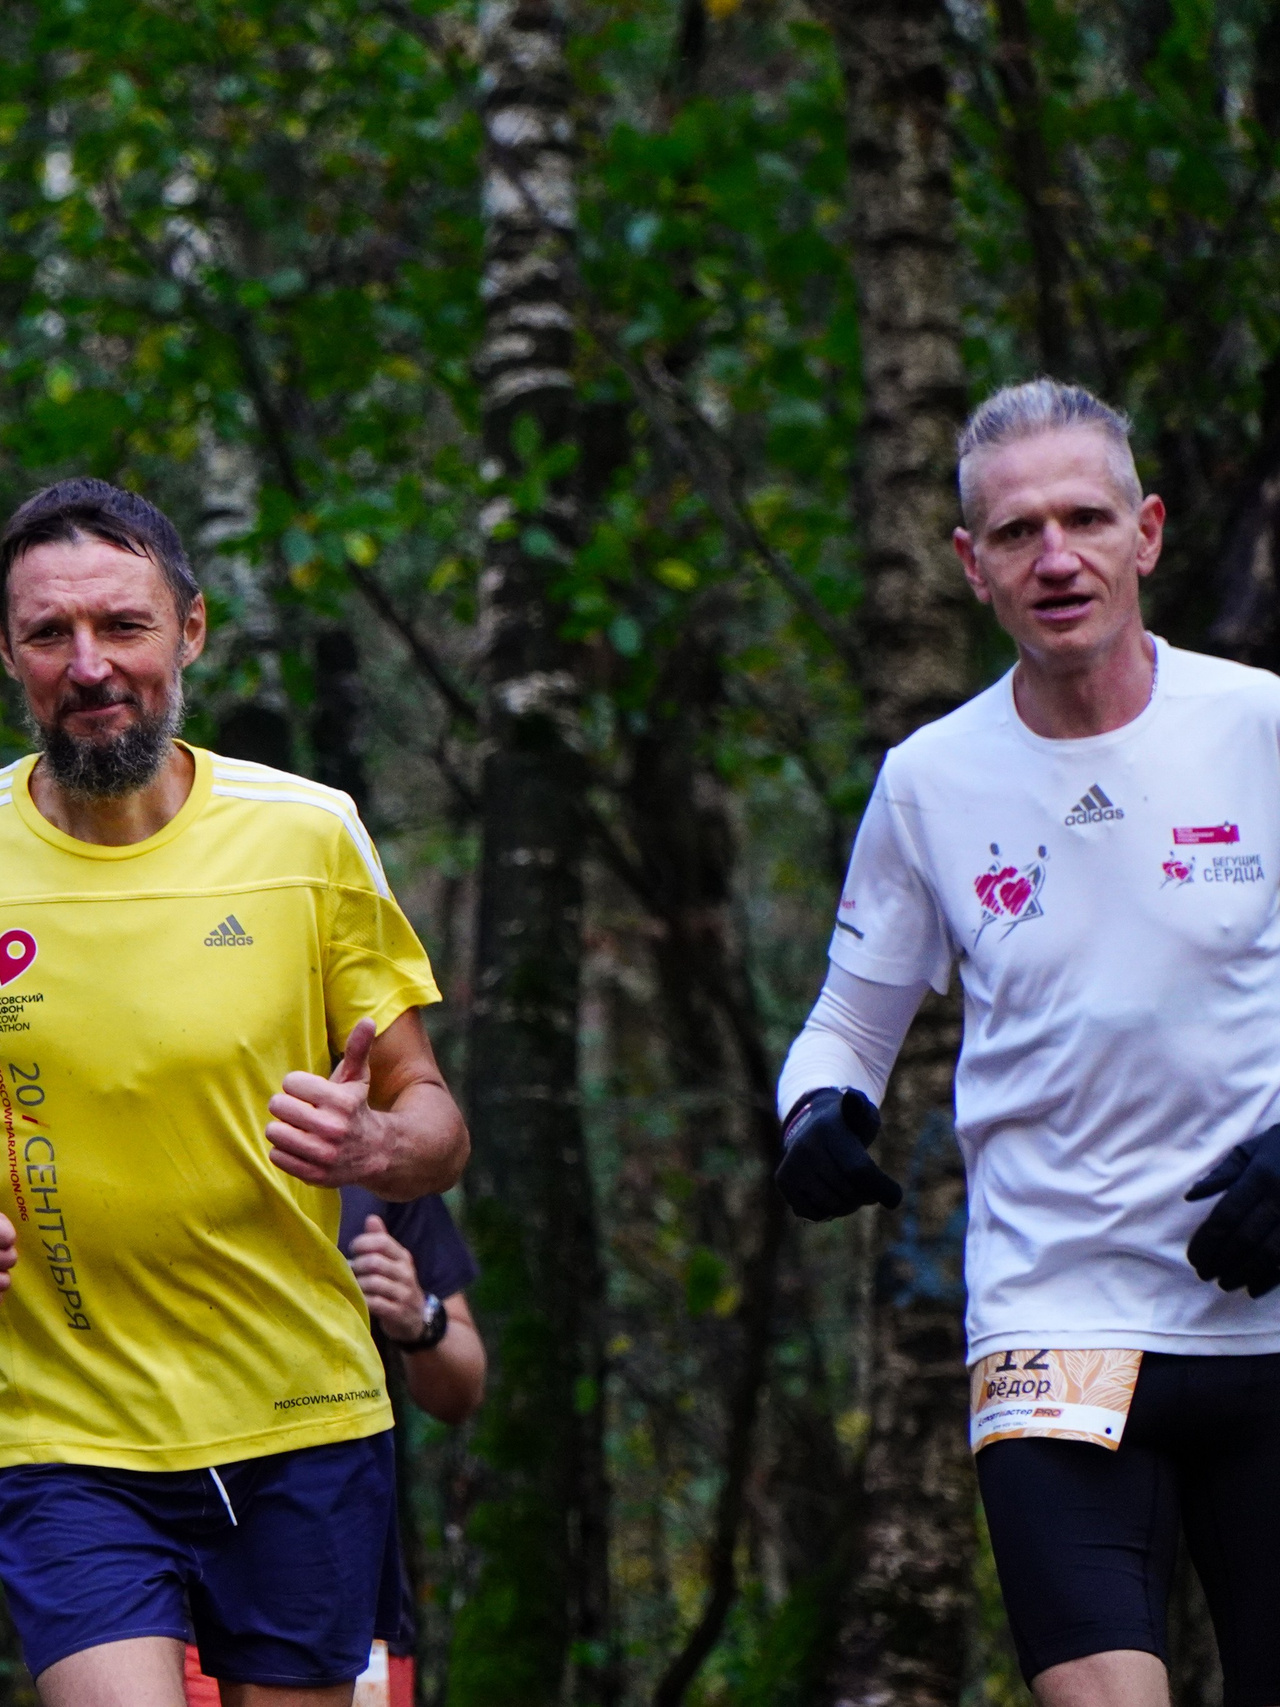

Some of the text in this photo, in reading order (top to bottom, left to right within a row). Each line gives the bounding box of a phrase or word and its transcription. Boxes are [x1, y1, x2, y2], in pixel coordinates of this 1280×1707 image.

[1065, 807, 1124, 826] adidas
[1203, 866, 1265, 884] СЕРДЦА
[203, 934, 254, 947] adidas
